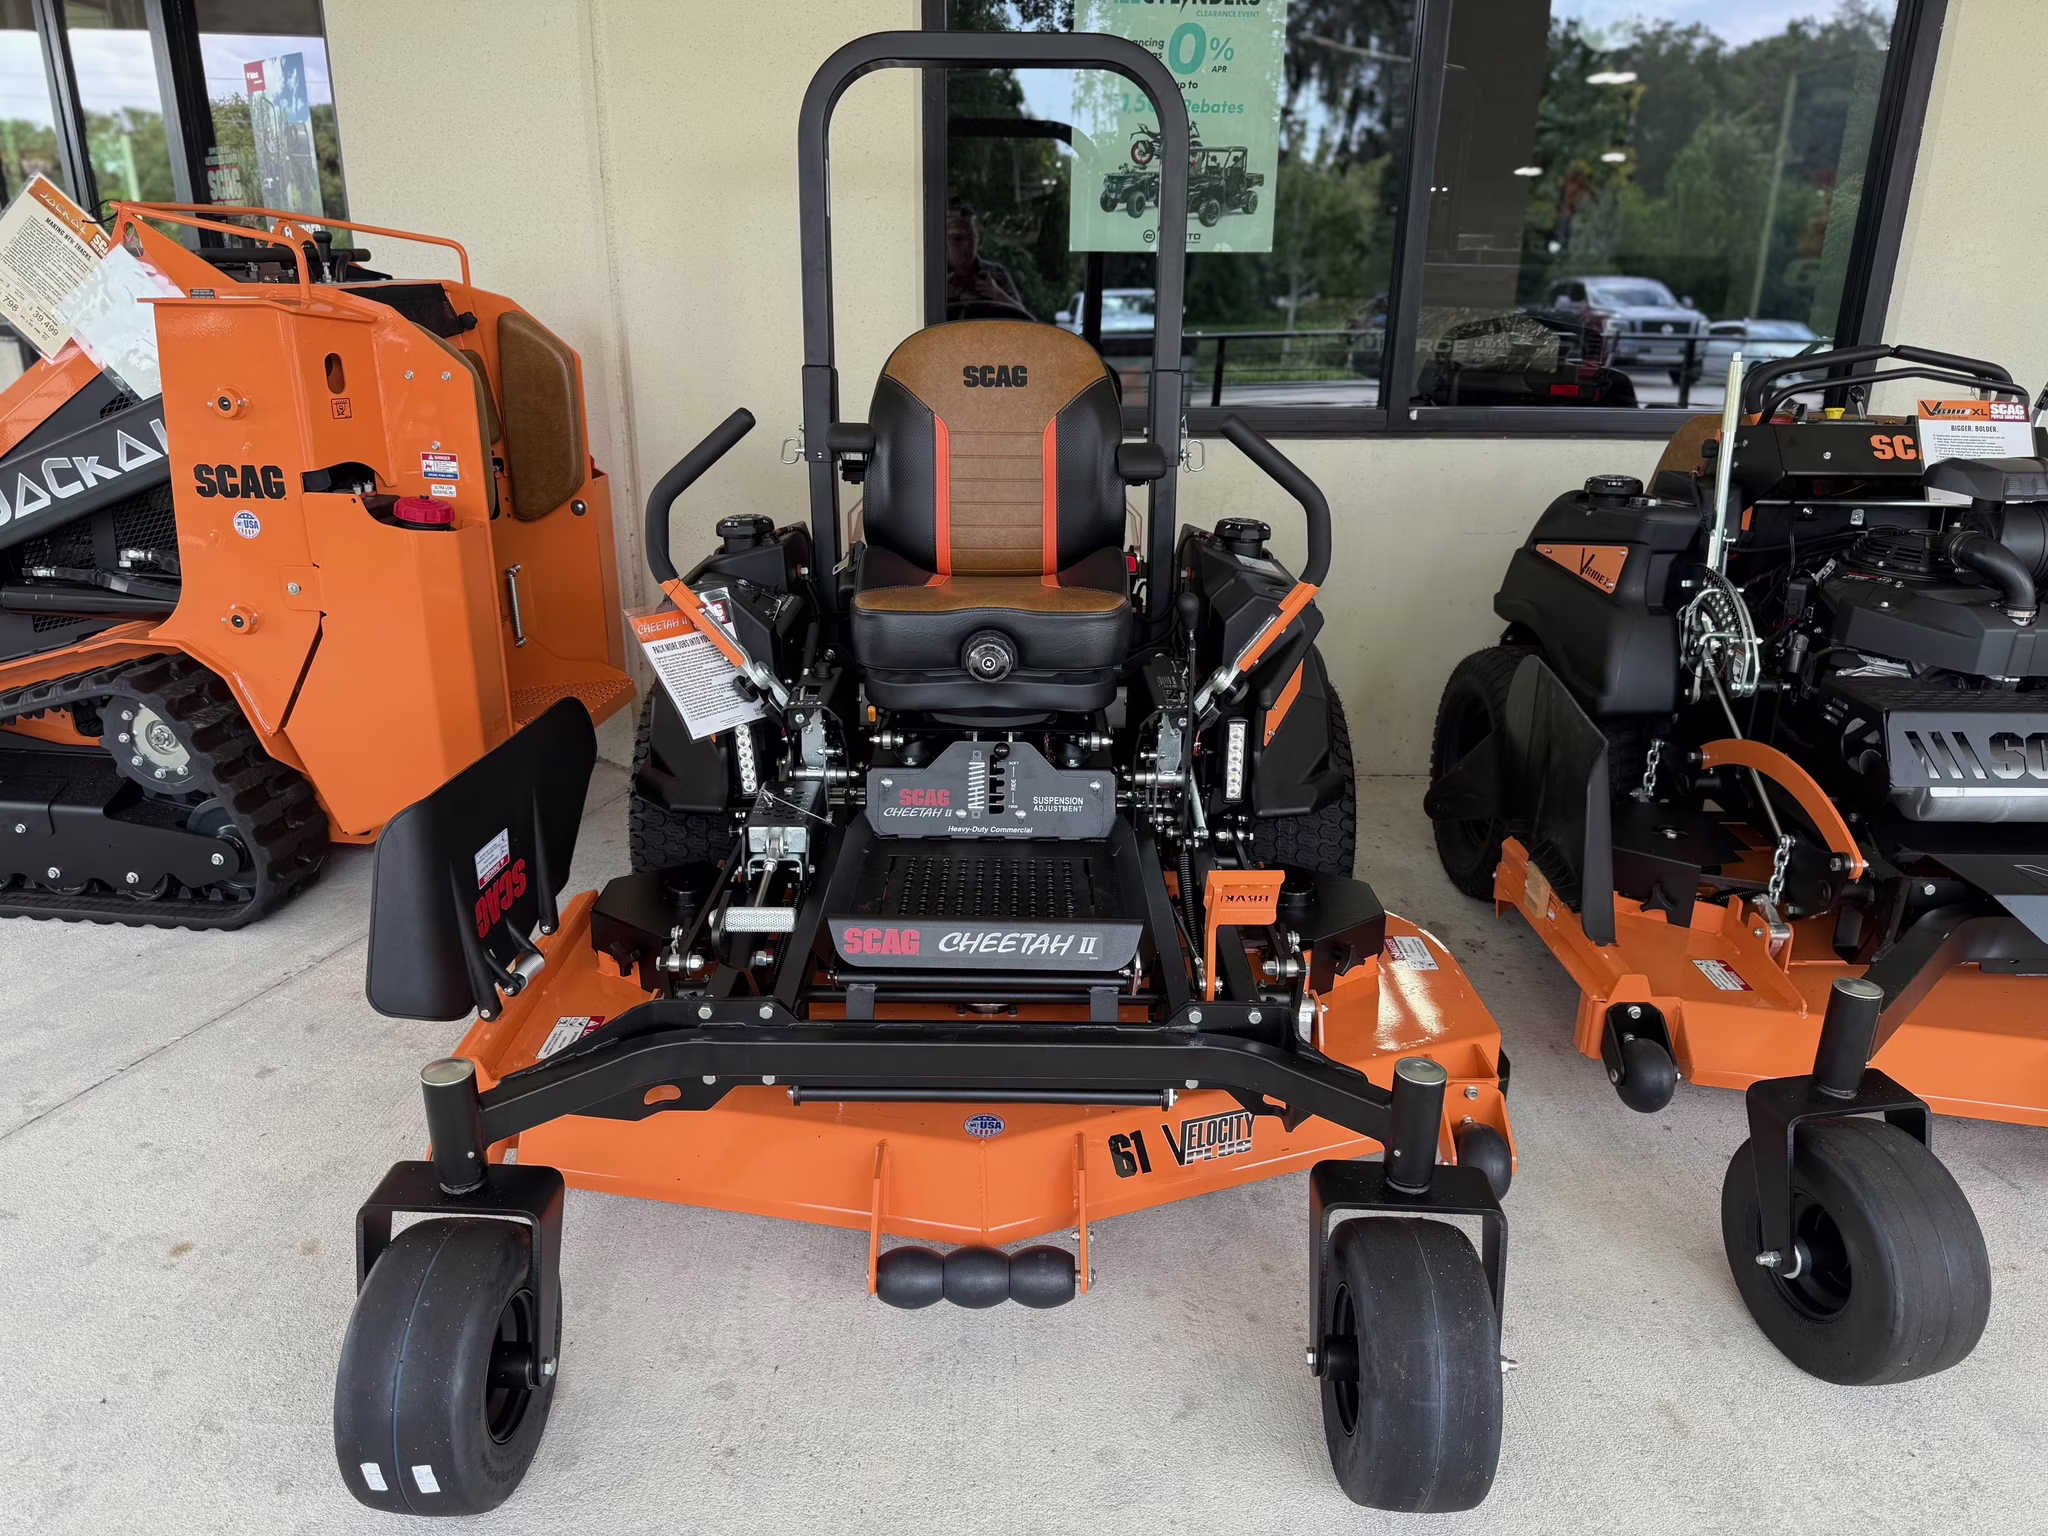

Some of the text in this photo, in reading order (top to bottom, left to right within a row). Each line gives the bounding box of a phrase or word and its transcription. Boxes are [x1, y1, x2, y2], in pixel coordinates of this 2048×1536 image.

[1196, 10, 1260, 18] CLEARANCE EVENT
[1131, 36, 1165, 49] ancing
[1211, 65, 1228, 73] APR
[1188, 80, 1199, 89] to
[1184, 98, 1244, 114] Rebates
[39, 191, 87, 236] JACKAL
[45, 217, 66, 236] MAKING
[64, 233, 77, 245] NEW
[32, 310, 59, 337] 39,499
[963, 365, 1027, 388] SCAG
[1971, 408, 1988, 416] XL
[1989, 403, 2025, 415] SCAG
[1975, 425, 1999, 433] BOLDER.
[1870, 434, 1922, 460] SC
[193, 463, 286, 500] SCAG
[243, 519, 259, 530] USA
[637, 618, 680, 635] CHEETAH
[651, 634, 711, 655] PACK MORE JOBS INTO YOU
[899, 788, 951, 807] SCAG
[1033, 796, 1084, 805] SUSPENSION
[883, 807, 953, 818] CHEETAH II
[1033, 804, 1083, 813] ADJUSTMENT
[948, 825, 1033, 834] Heavy-Duty Commercial
[475, 858, 527, 939] SCAG
[1220, 894, 1269, 903] BRAK
[843, 927, 1099, 956] SCAG CHEETAH II
[979, 1121, 1002, 1130] USA
[1160, 1110, 1256, 1166] VELOCITY
[1107, 1129, 1152, 1179] 61
[1186, 1140, 1252, 1165] PLUS
